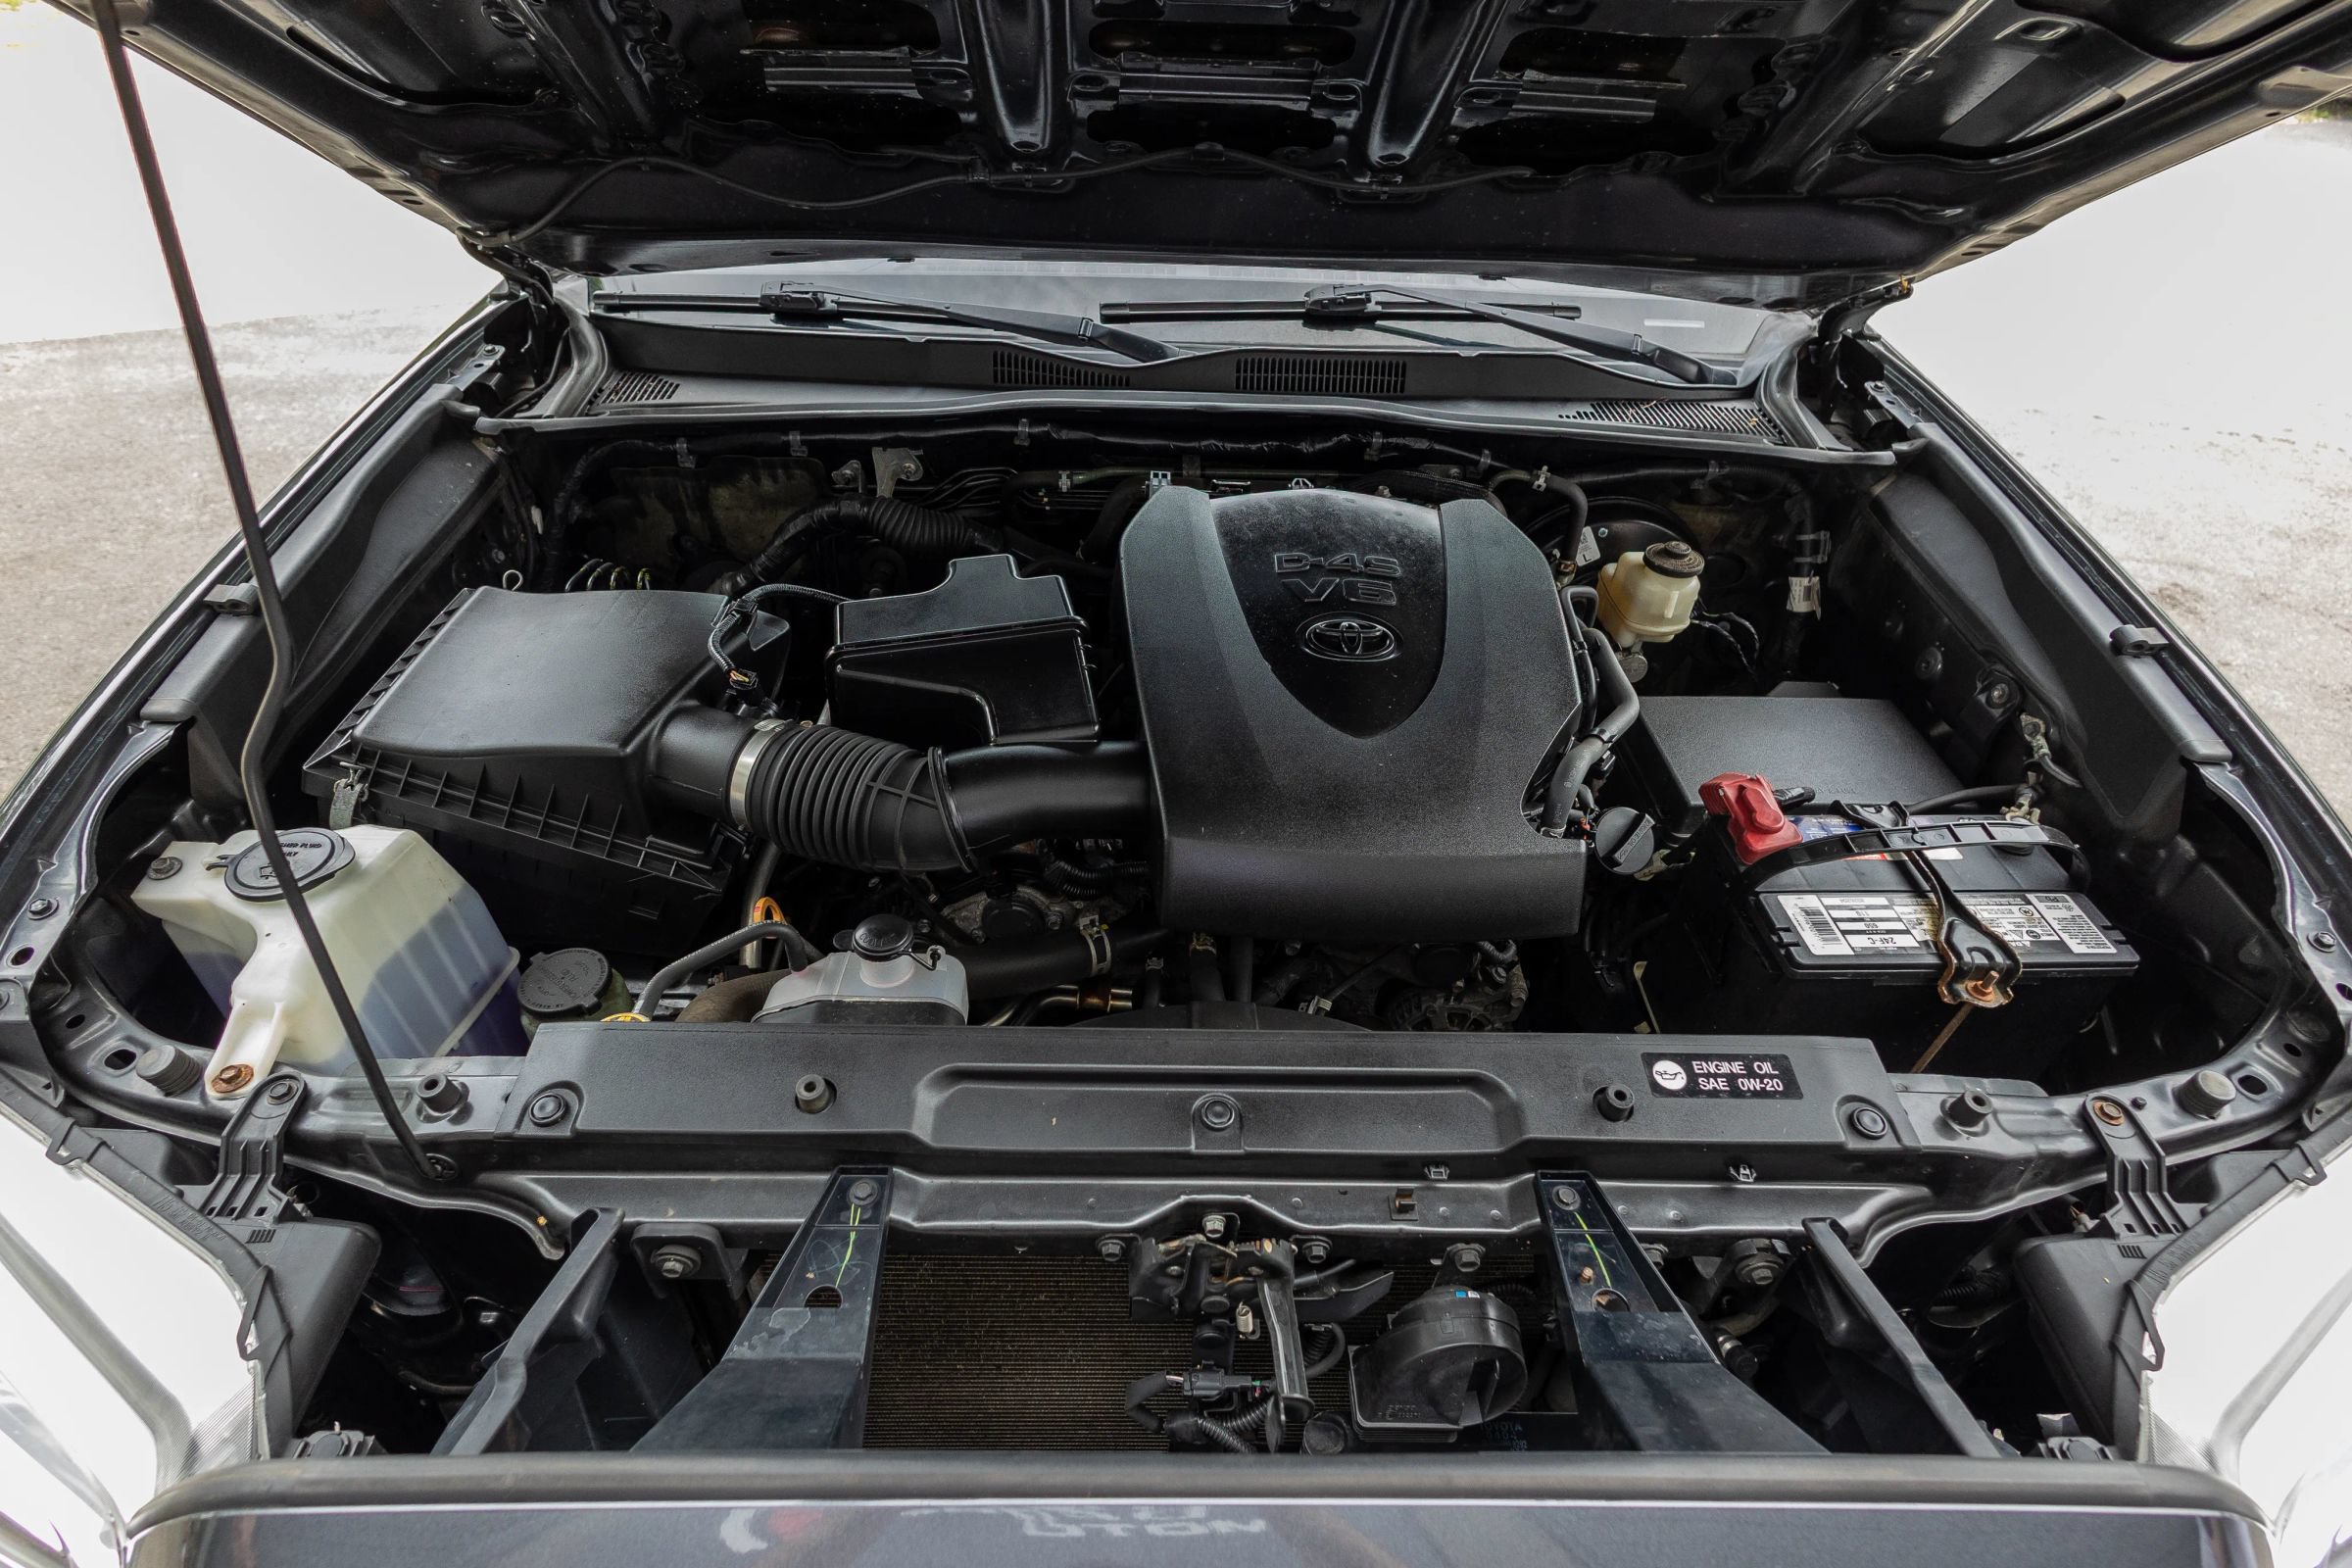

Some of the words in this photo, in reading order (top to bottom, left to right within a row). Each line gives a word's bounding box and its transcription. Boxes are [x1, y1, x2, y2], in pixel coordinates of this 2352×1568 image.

[1274, 552, 1401, 578] D-4S
[1282, 576, 1396, 606] V6
[1868, 936, 1897, 946] 24F-C
[1691, 1061, 1746, 1074] ENGINE
[1753, 1061, 1779, 1075] OIL
[1698, 1078, 1730, 1091] SAE
[1738, 1078, 1784, 1092] 0W-20
